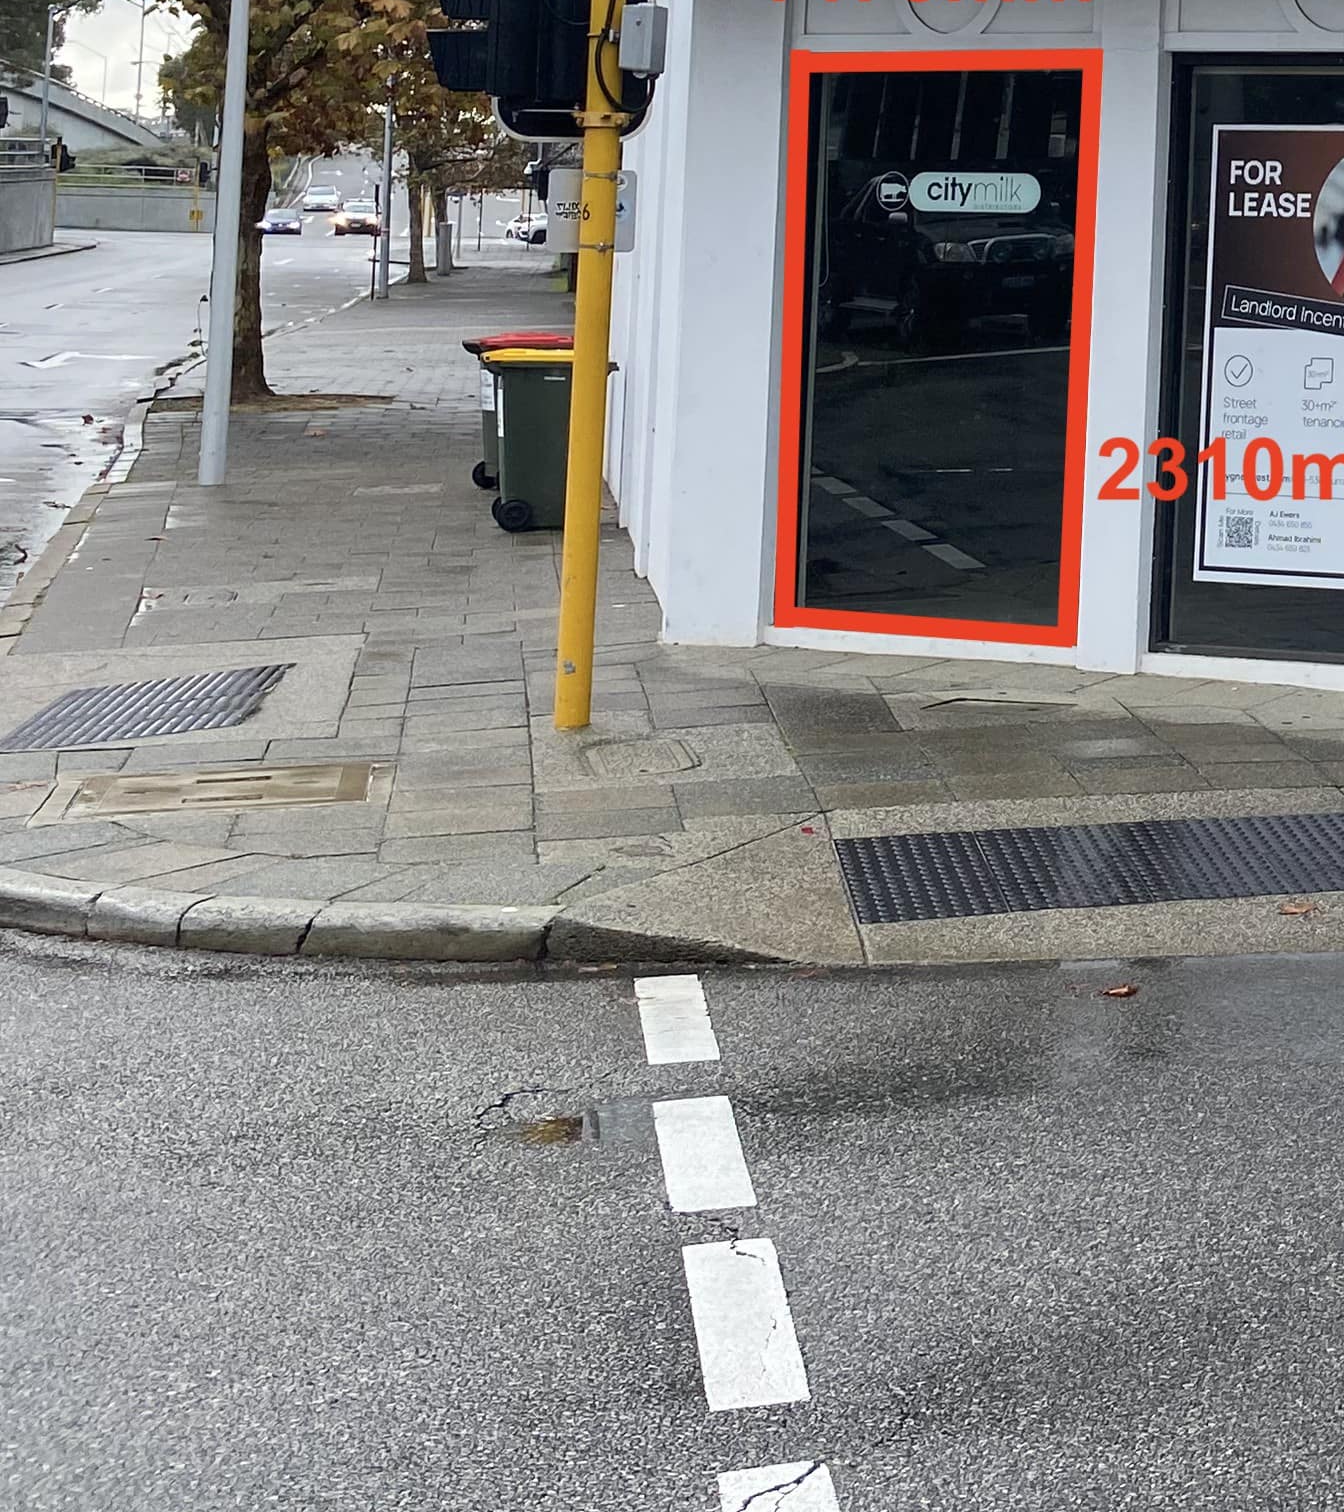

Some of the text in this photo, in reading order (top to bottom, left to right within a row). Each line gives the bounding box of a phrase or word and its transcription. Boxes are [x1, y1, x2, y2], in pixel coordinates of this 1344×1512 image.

[1229, 160, 1282, 186] FOR
[1227, 192, 1312, 219] LEASE
[1230, 295, 1297, 322] Landlord
[1223, 396, 1257, 410] Street
[1223, 412, 1269, 429] frontage
[1221, 428, 1248, 440] retail
